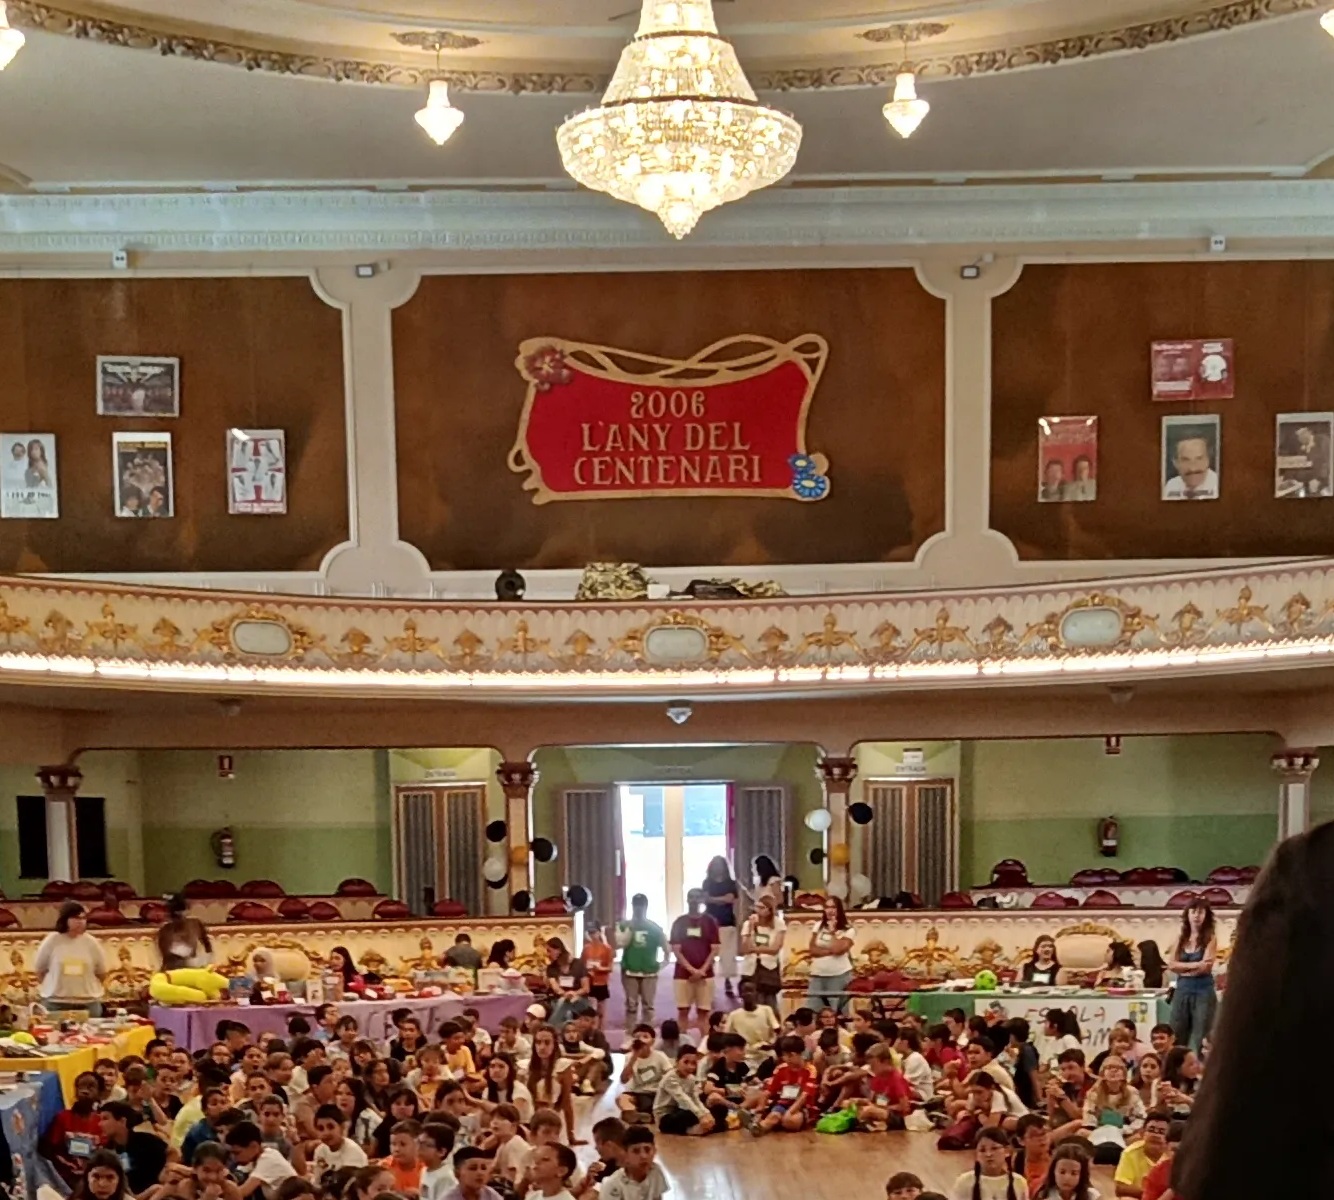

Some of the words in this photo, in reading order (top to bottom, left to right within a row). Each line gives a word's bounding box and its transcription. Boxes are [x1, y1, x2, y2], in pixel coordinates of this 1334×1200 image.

[630, 390, 705, 418] 2006
[684, 421, 751, 452] DEL
[573, 454, 762, 485] CENTENARI
